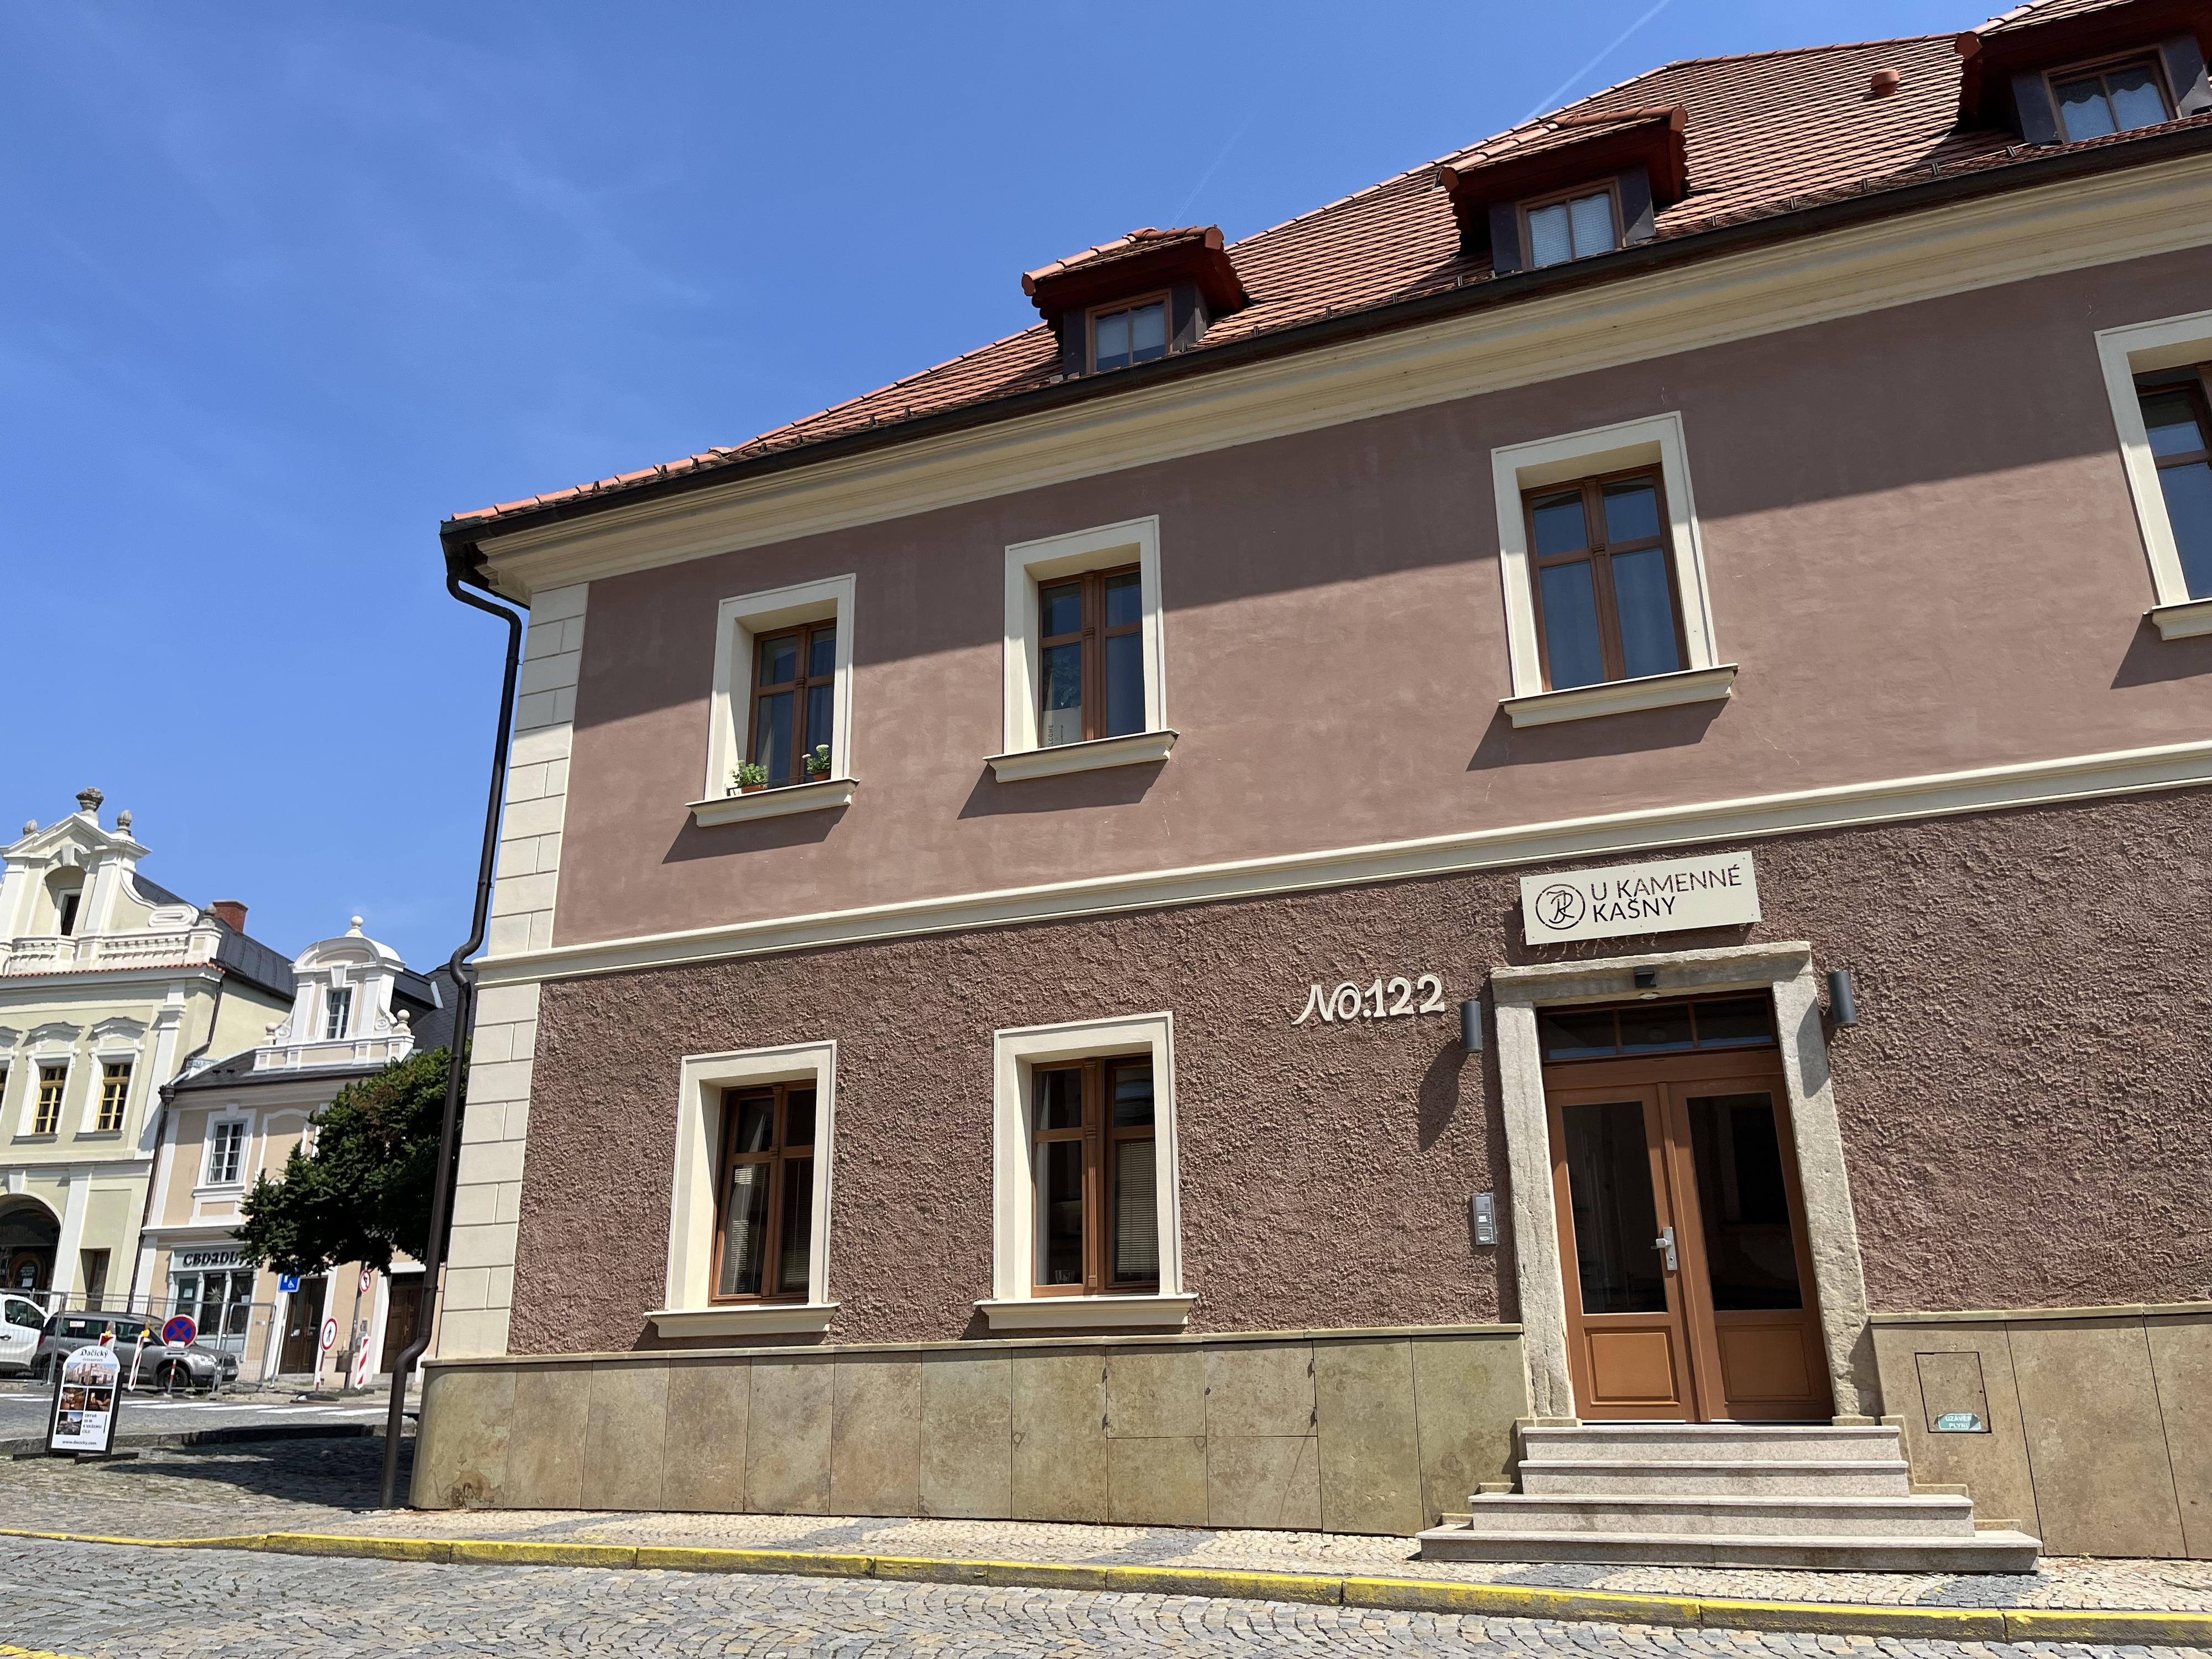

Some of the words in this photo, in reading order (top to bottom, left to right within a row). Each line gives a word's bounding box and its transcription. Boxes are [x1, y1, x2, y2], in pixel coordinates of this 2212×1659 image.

[1590, 882, 1608, 901] U
[1616, 864, 1742, 899] KAMENNÉ
[1593, 896, 1676, 923] KAŠNY
